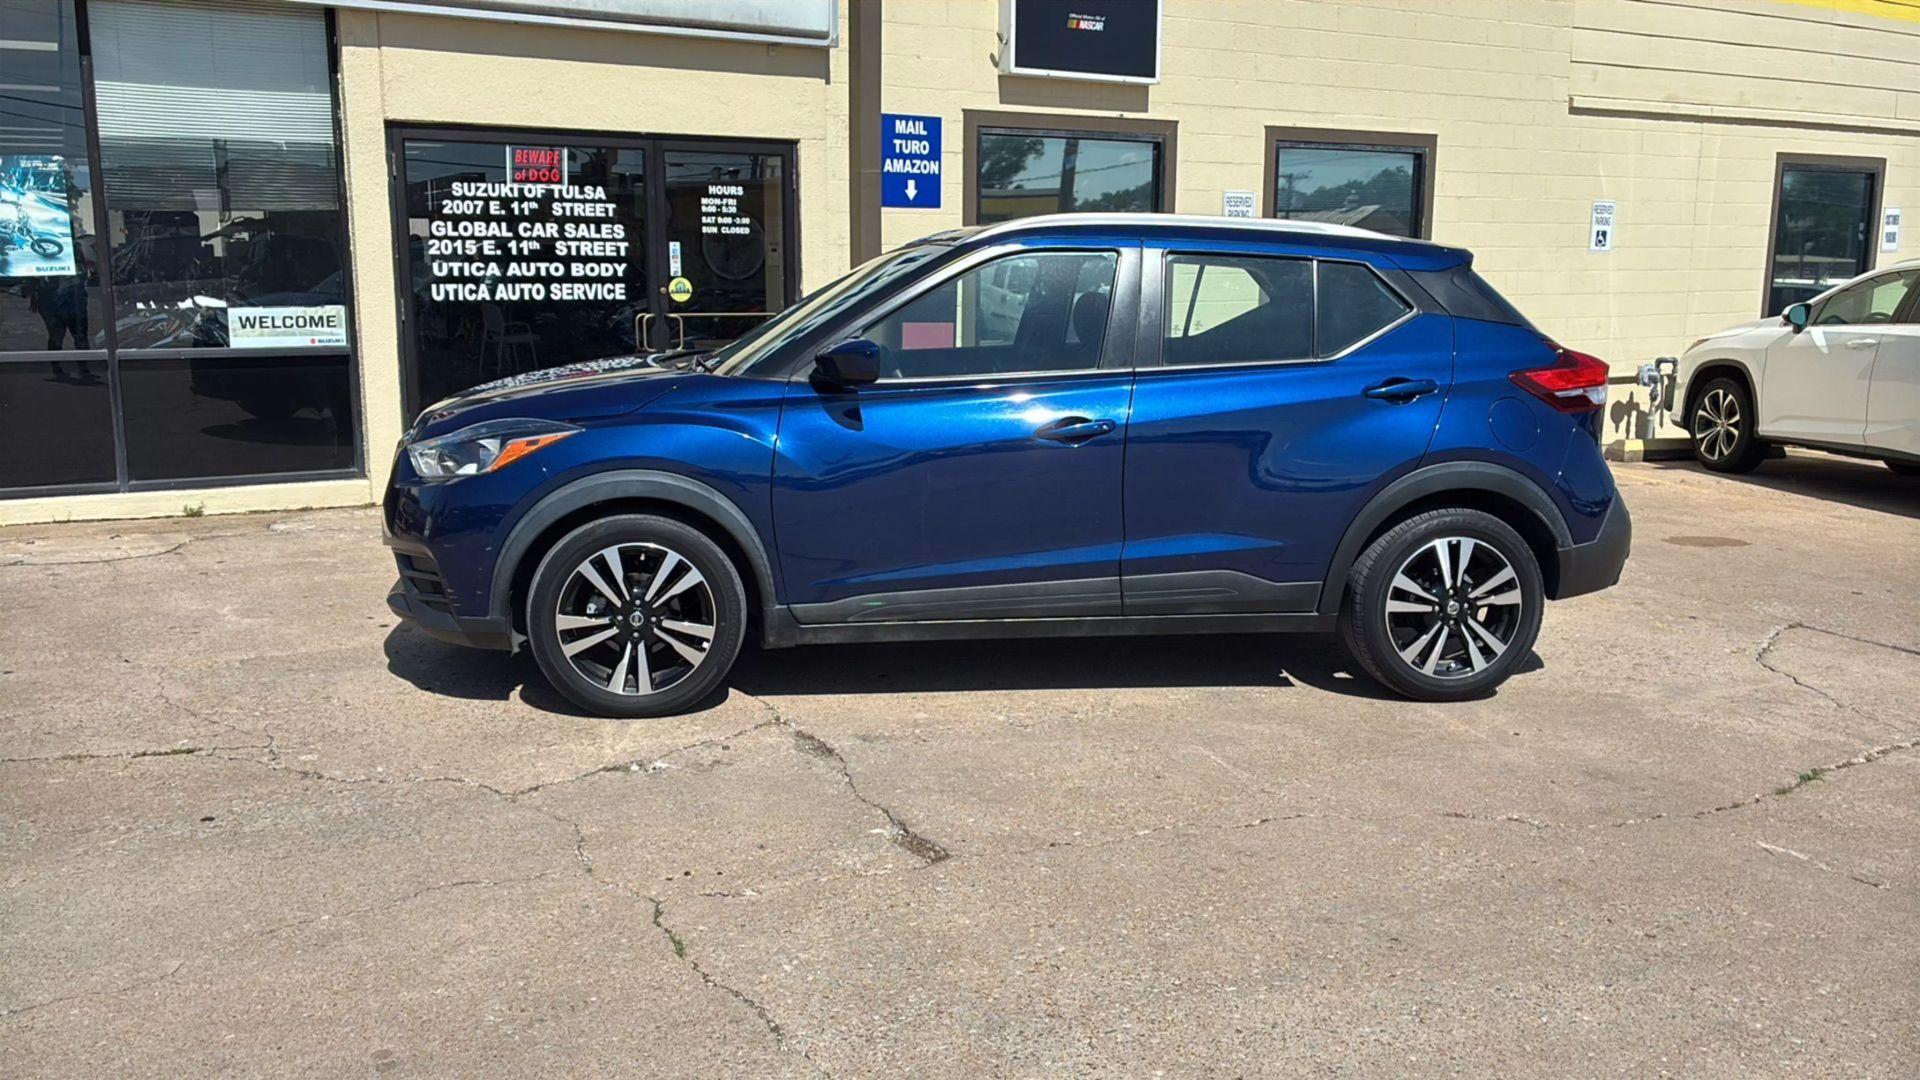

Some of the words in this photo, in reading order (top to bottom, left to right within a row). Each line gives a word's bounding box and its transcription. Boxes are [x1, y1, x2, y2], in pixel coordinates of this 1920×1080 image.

[1079, 19, 1104, 31] NASCAR
[895, 119, 927, 135] MAIL
[893, 139, 930, 155] TURO
[515, 149, 561, 166] BEWARE
[883, 158, 939, 174] AMAZON
[514, 170, 527, 181] of
[528, 169, 561, 182] DOG
[451, 182, 519, 198] SUZUKI
[523, 185, 546, 198] OF
[552, 185, 607, 200] TULSA
[708, 185, 744, 195] HOURS
[442, 200, 483, 214] 2007
[489, 201, 505, 214] E.
[511, 201, 538, 215] 11th
[551, 203, 617, 217] STREET
[701, 197, 737, 206] MON-FRI
[702, 216, 716, 224] SAT
[431, 221, 513, 237] GLOBAL
[518, 222, 559, 238] CAR
[564, 223, 625, 239] SALES
[702, 226, 718, 234] SUN
[720, 226, 750, 234] CLOSED
[428, 240, 477, 255] 2015
[483, 241, 501, 255] E.
[508, 240, 540, 256] 11th
[555, 241, 629, 256] STREET
[432, 262, 501, 277] UTICA
[506, 262, 565, 277] AUTO
[570, 263, 627, 277] BODY
[431, 283, 491, 301] UTICA
[495, 283, 546, 301] AUTO
[550, 283, 626, 300] SERVICE
[238, 315, 337, 329] WELCOME
